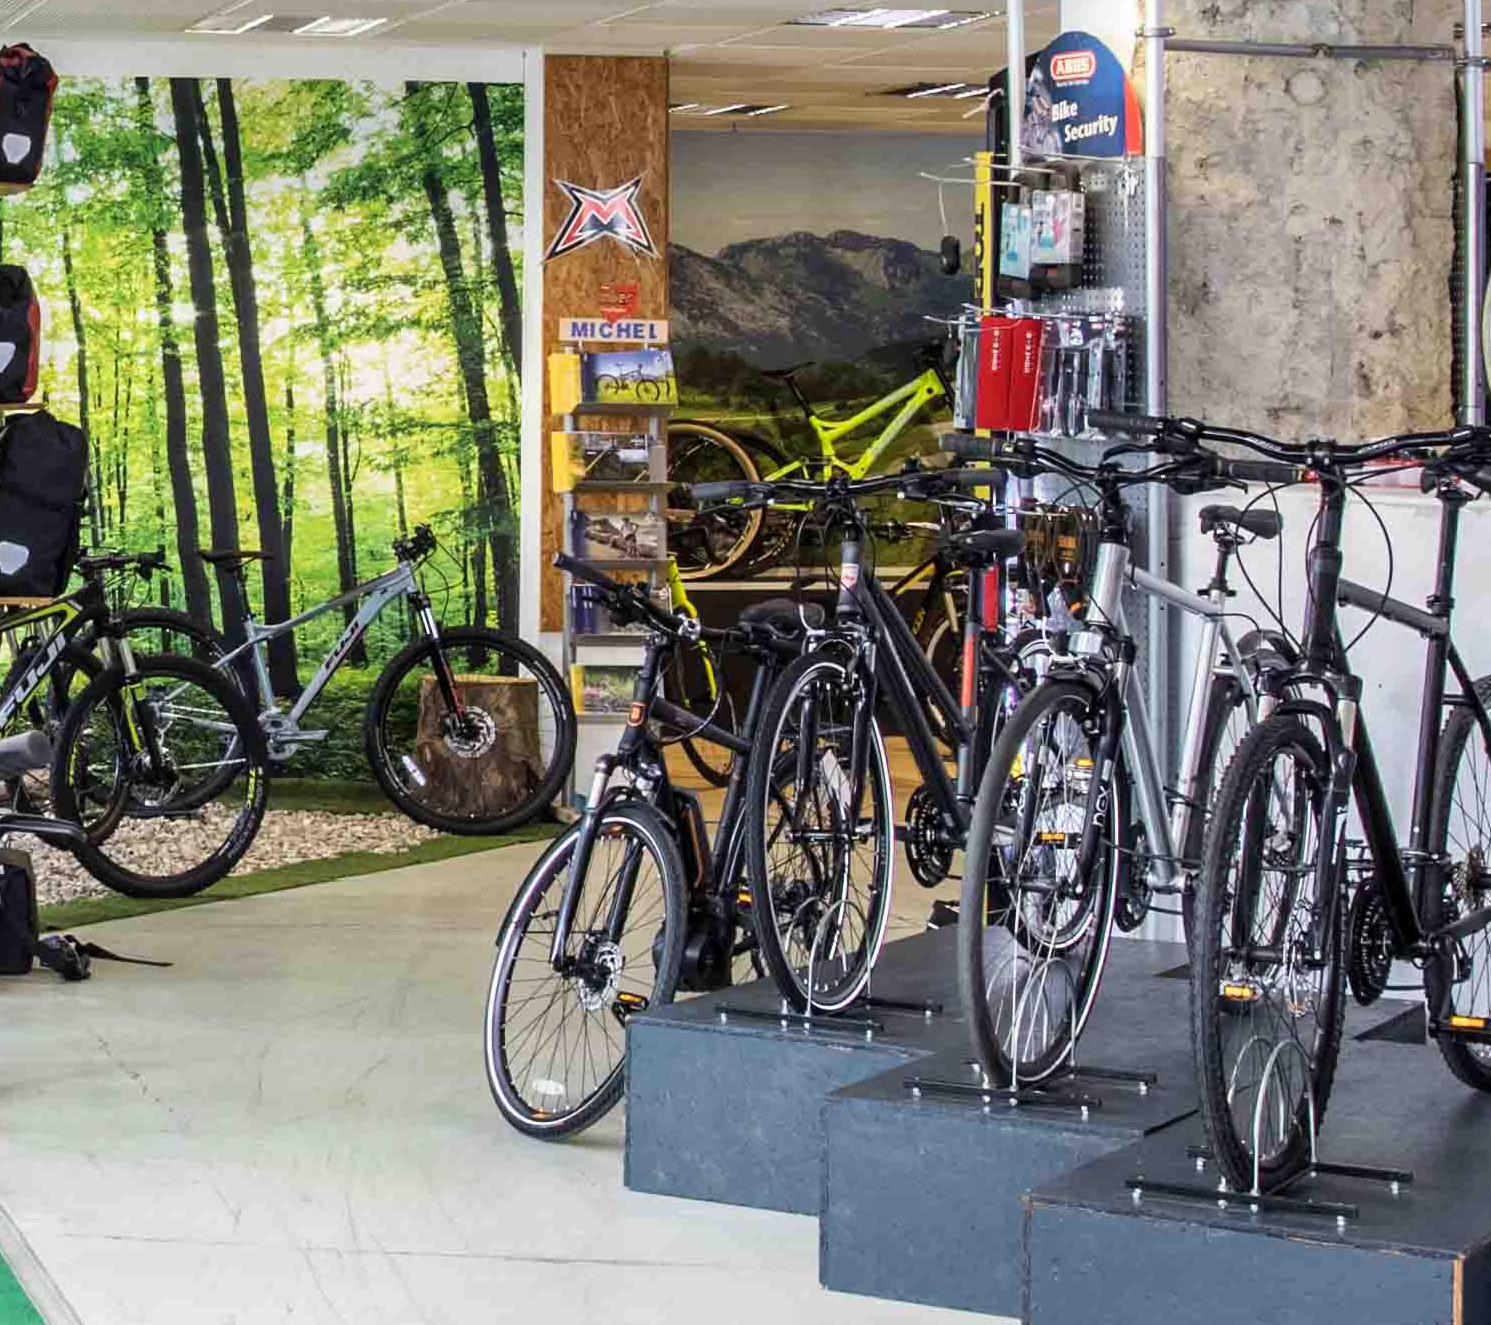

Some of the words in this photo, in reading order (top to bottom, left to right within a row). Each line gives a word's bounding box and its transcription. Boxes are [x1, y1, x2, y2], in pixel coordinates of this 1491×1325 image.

[1055, 56, 1090, 76] ABUS
[1051, 99, 1078, 123] Bike
[1064, 114, 1118, 143] Security
[571, 321, 658, 339] MICHEL
[319, 618, 361, 673] FUJI
